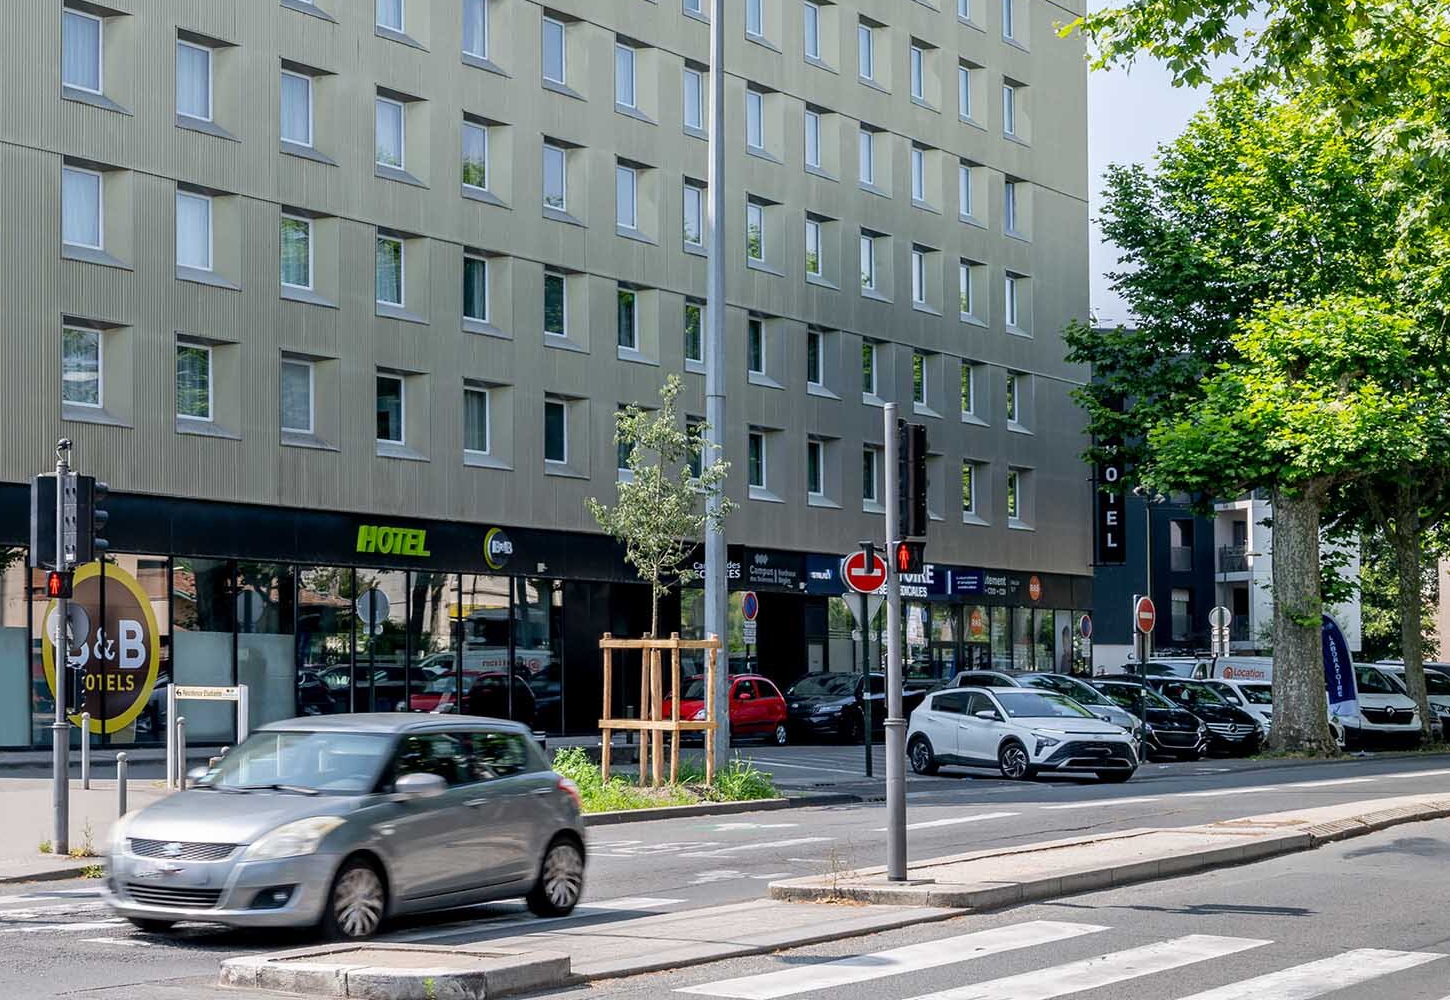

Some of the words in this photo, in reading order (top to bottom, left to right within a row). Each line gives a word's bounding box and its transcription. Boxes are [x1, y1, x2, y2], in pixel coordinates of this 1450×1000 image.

[356, 525, 430, 557] HOTEL
[727, 561, 741, 569] des
[1234, 668, 1265, 678] Location
[1328, 635, 1343, 697] LABORATOIRE
[86, 674, 135, 691] OTELS
